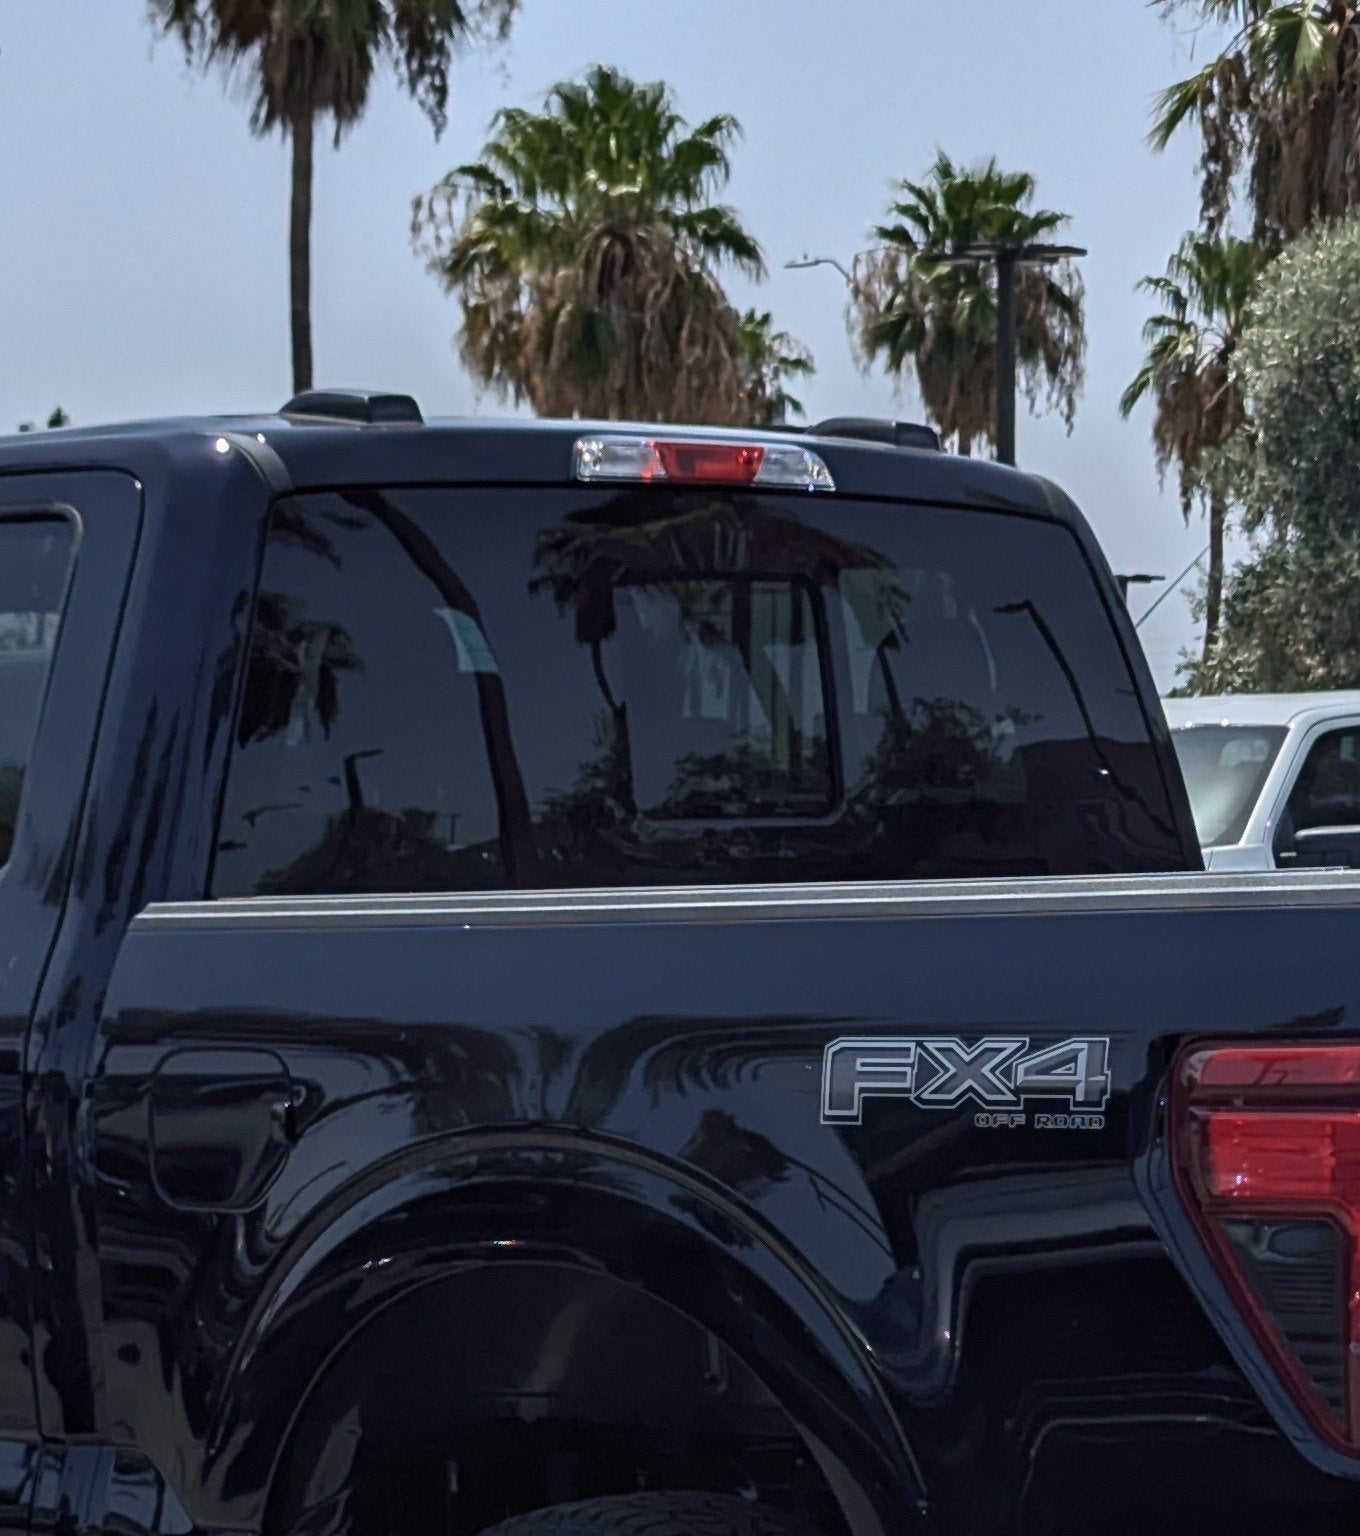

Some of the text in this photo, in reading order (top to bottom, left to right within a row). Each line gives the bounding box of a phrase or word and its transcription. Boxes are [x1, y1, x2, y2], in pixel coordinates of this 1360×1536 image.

[820, 1036, 1111, 1126] FX4
[974, 1113, 1106, 1130] OFF ROAD
